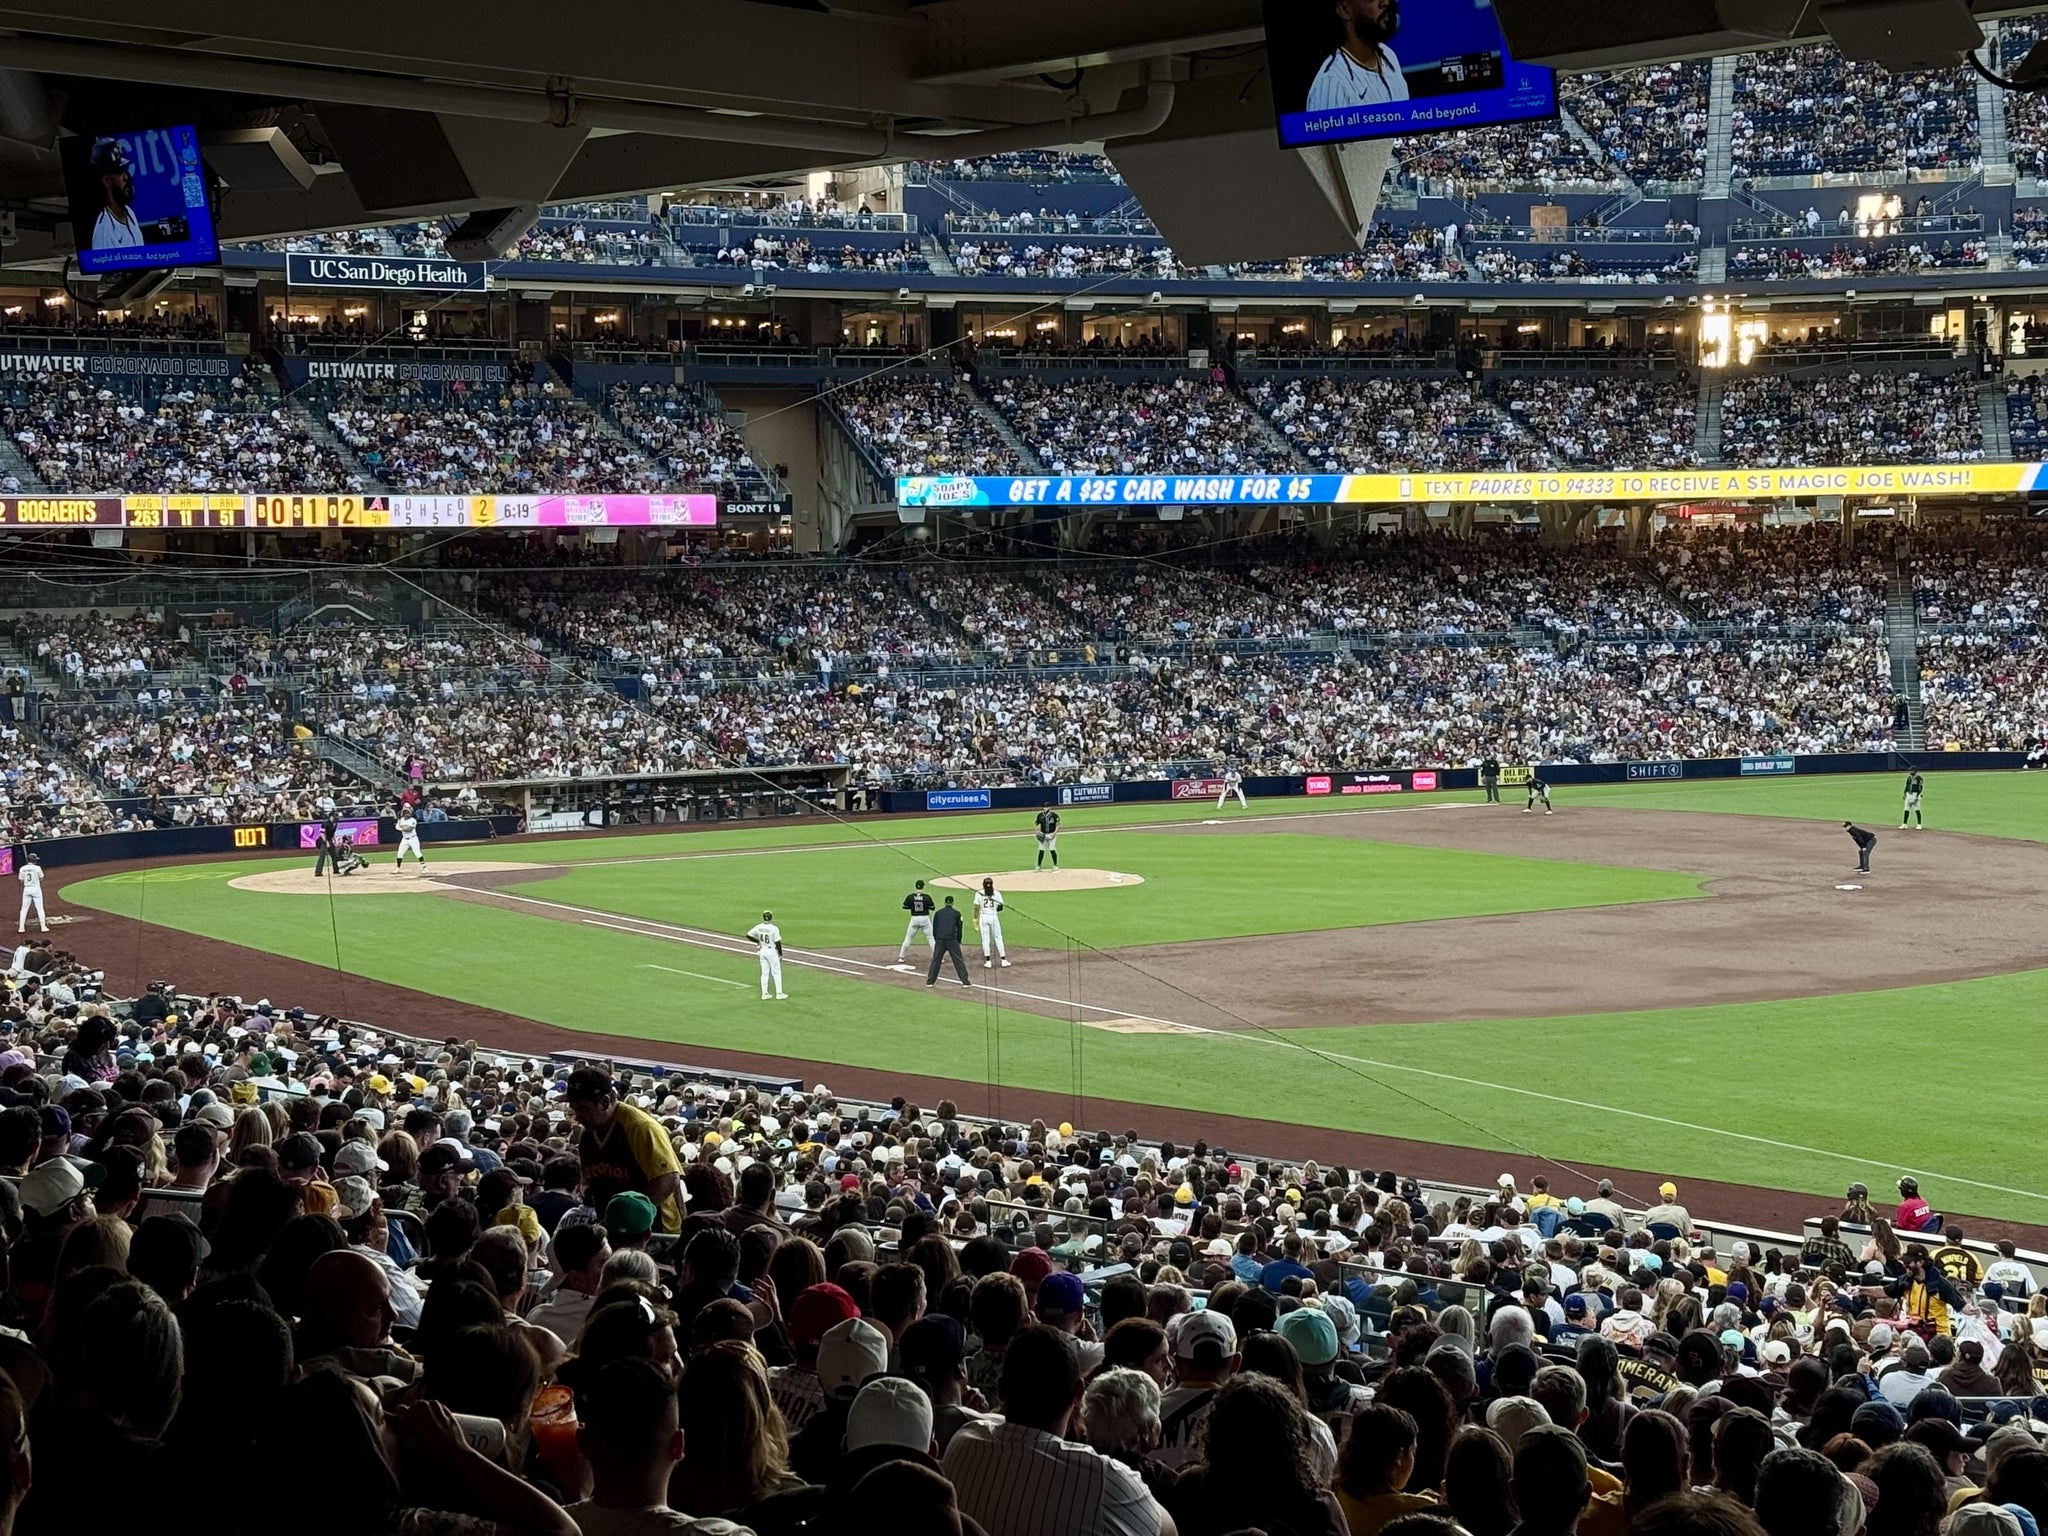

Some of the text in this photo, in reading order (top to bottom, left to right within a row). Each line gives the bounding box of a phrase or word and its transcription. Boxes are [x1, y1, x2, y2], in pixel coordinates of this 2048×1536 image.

[1304, 102, 1481, 133] Helpful all season. And beyond.
[92, 254, 113, 265] Helpful
[146, 252, 158, 260] And
[309, 259, 468, 285] UC San Diego Health
[0, 354, 229, 376] UTWATER CORONADO CLUB
[308, 362, 395, 379] CUTWATER
[400, 363, 482, 381] CORONADO
[933, 481, 971, 492] SOAPY
[1008, 476, 1313, 502] GET A $25 CAR WASH FOR $5
[1424, 470, 1971, 495] TEXT PADRES TO 94333 TO RECEIVE A $5 MAGIC JOE WASH!
[18, 500, 97, 522] BOGAERTS
[136, 499, 152, 508] AVG
[180, 499, 192, 508] HR
[220, 499, 234, 508] RBI
[258, 504, 266, 519] B
[272, 498, 285, 524] 0
[293, 504, 302, 519] S
[309, 498, 316, 524] 1
[342, 498, 354, 524] 2
[394, 503, 452, 517] R H E
[405, 498, 411, 511] 0
[458, 498, 464, 511] 0
[479, 499, 487, 517] 2
[504, 503, 529, 518] 6:19
[727, 504, 769, 513] SONY
[130, 510, 160, 526] .263
[179, 510, 193, 526] 11
[220, 510, 235, 526] 51
[405, 512, 464, 525] 5 5 0
[1073, 787, 1110, 796] CUTWATER
[1177, 784, 1206, 797] Roma
[930, 794, 979, 806] citycruises
[234, 827, 267, 847] 007
[26, 873, 32, 881] 3
[983, 898, 995, 908] 23
[1617, 1360, 1678, 1392] OMERAN
